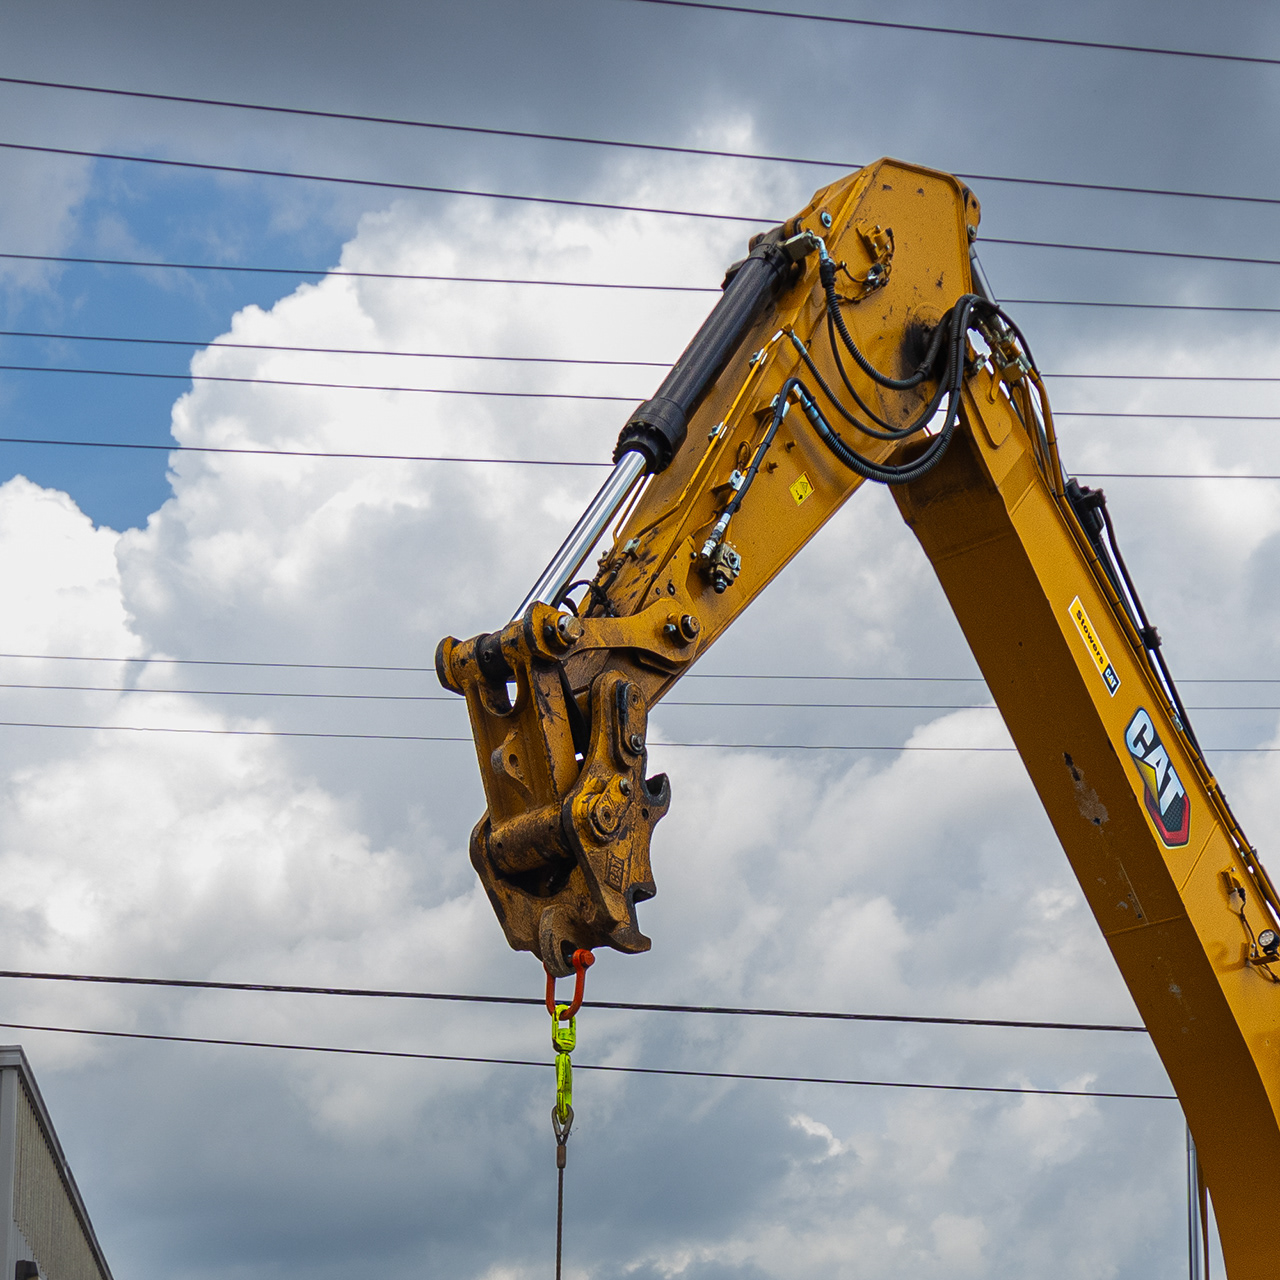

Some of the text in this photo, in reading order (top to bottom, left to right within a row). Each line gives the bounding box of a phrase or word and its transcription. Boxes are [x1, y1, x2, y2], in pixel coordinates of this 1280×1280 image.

[1076, 609, 1118, 689] Stowers CAT
[1125, 708, 1186, 817] CAT
